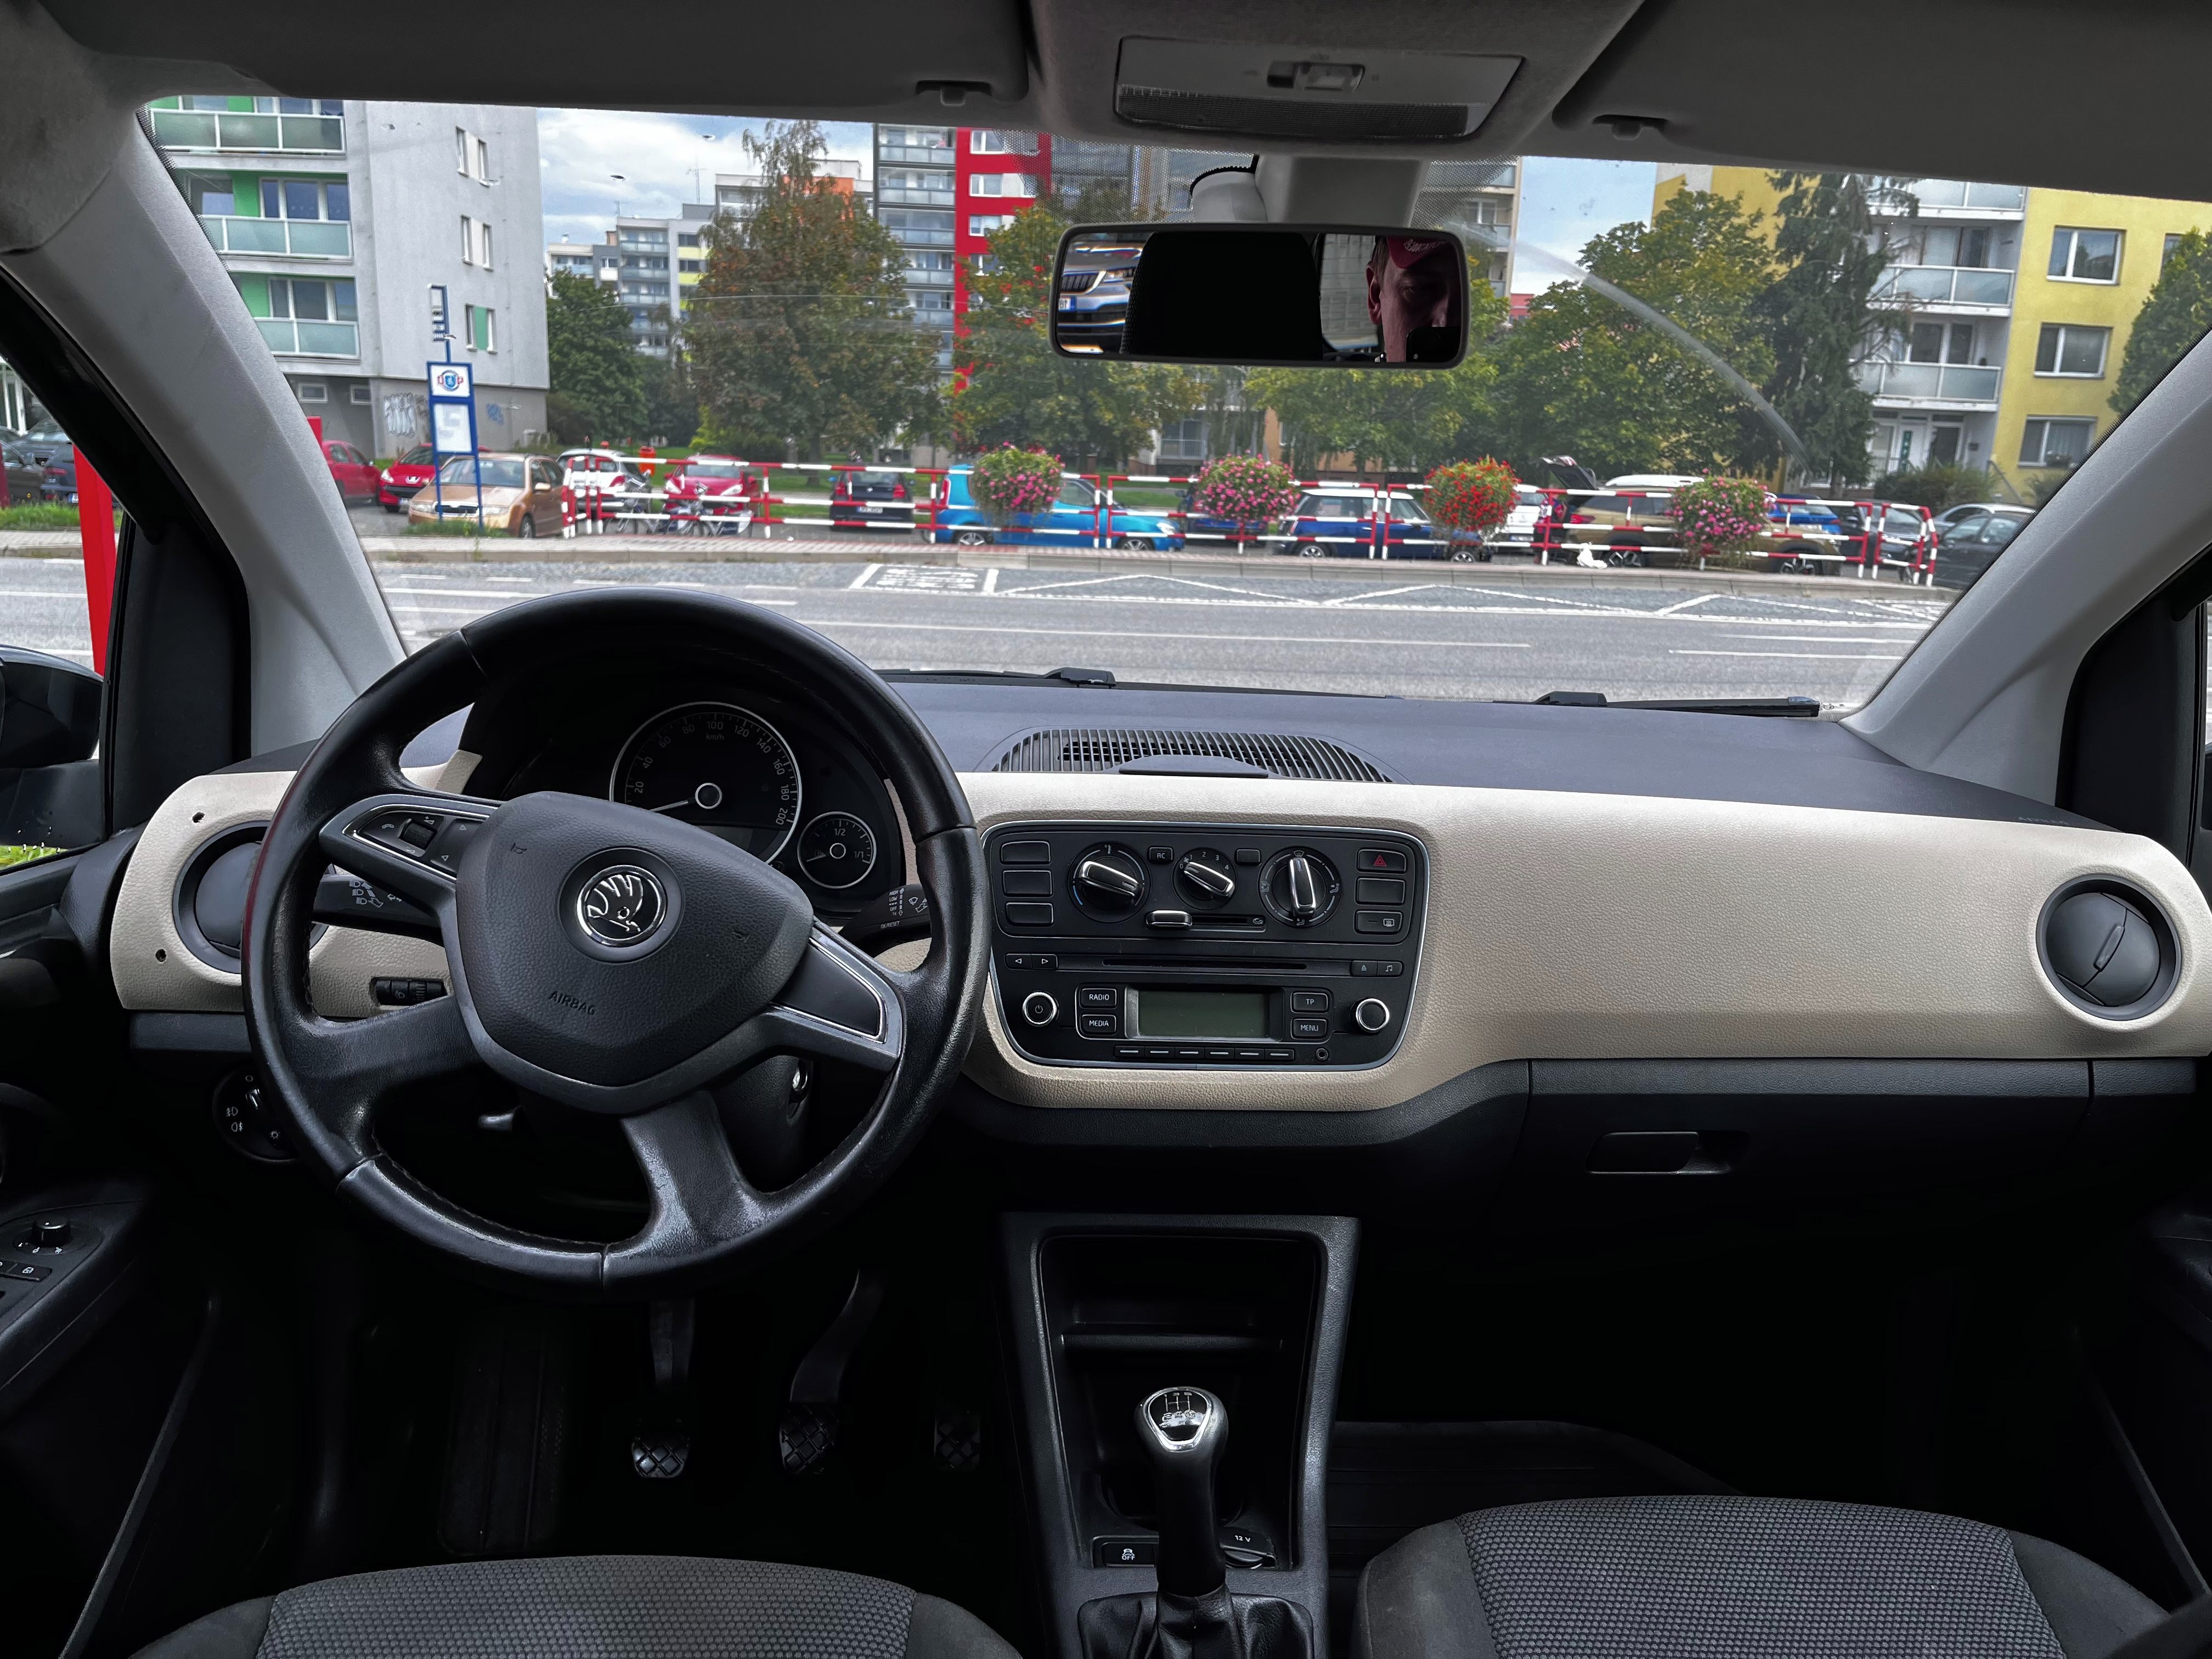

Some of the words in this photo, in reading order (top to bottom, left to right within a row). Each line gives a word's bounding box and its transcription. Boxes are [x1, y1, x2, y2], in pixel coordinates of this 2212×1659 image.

[682, 724, 695, 734] 80
[707, 721, 724, 730] 100
[734, 725, 749, 737] 120
[659, 736, 671, 748] 60
[757, 738, 771, 753] 140
[642, 757, 653, 769] 40
[773, 759, 785, 775] 160
[634, 781, 644, 793] 20
[781, 784, 789, 800] 180
[776, 808, 788, 825] 200
[834, 828, 846, 836] 1/2
[854, 850, 864, 859] 1/1
[549, 991, 596, 1015] AIRBAG
